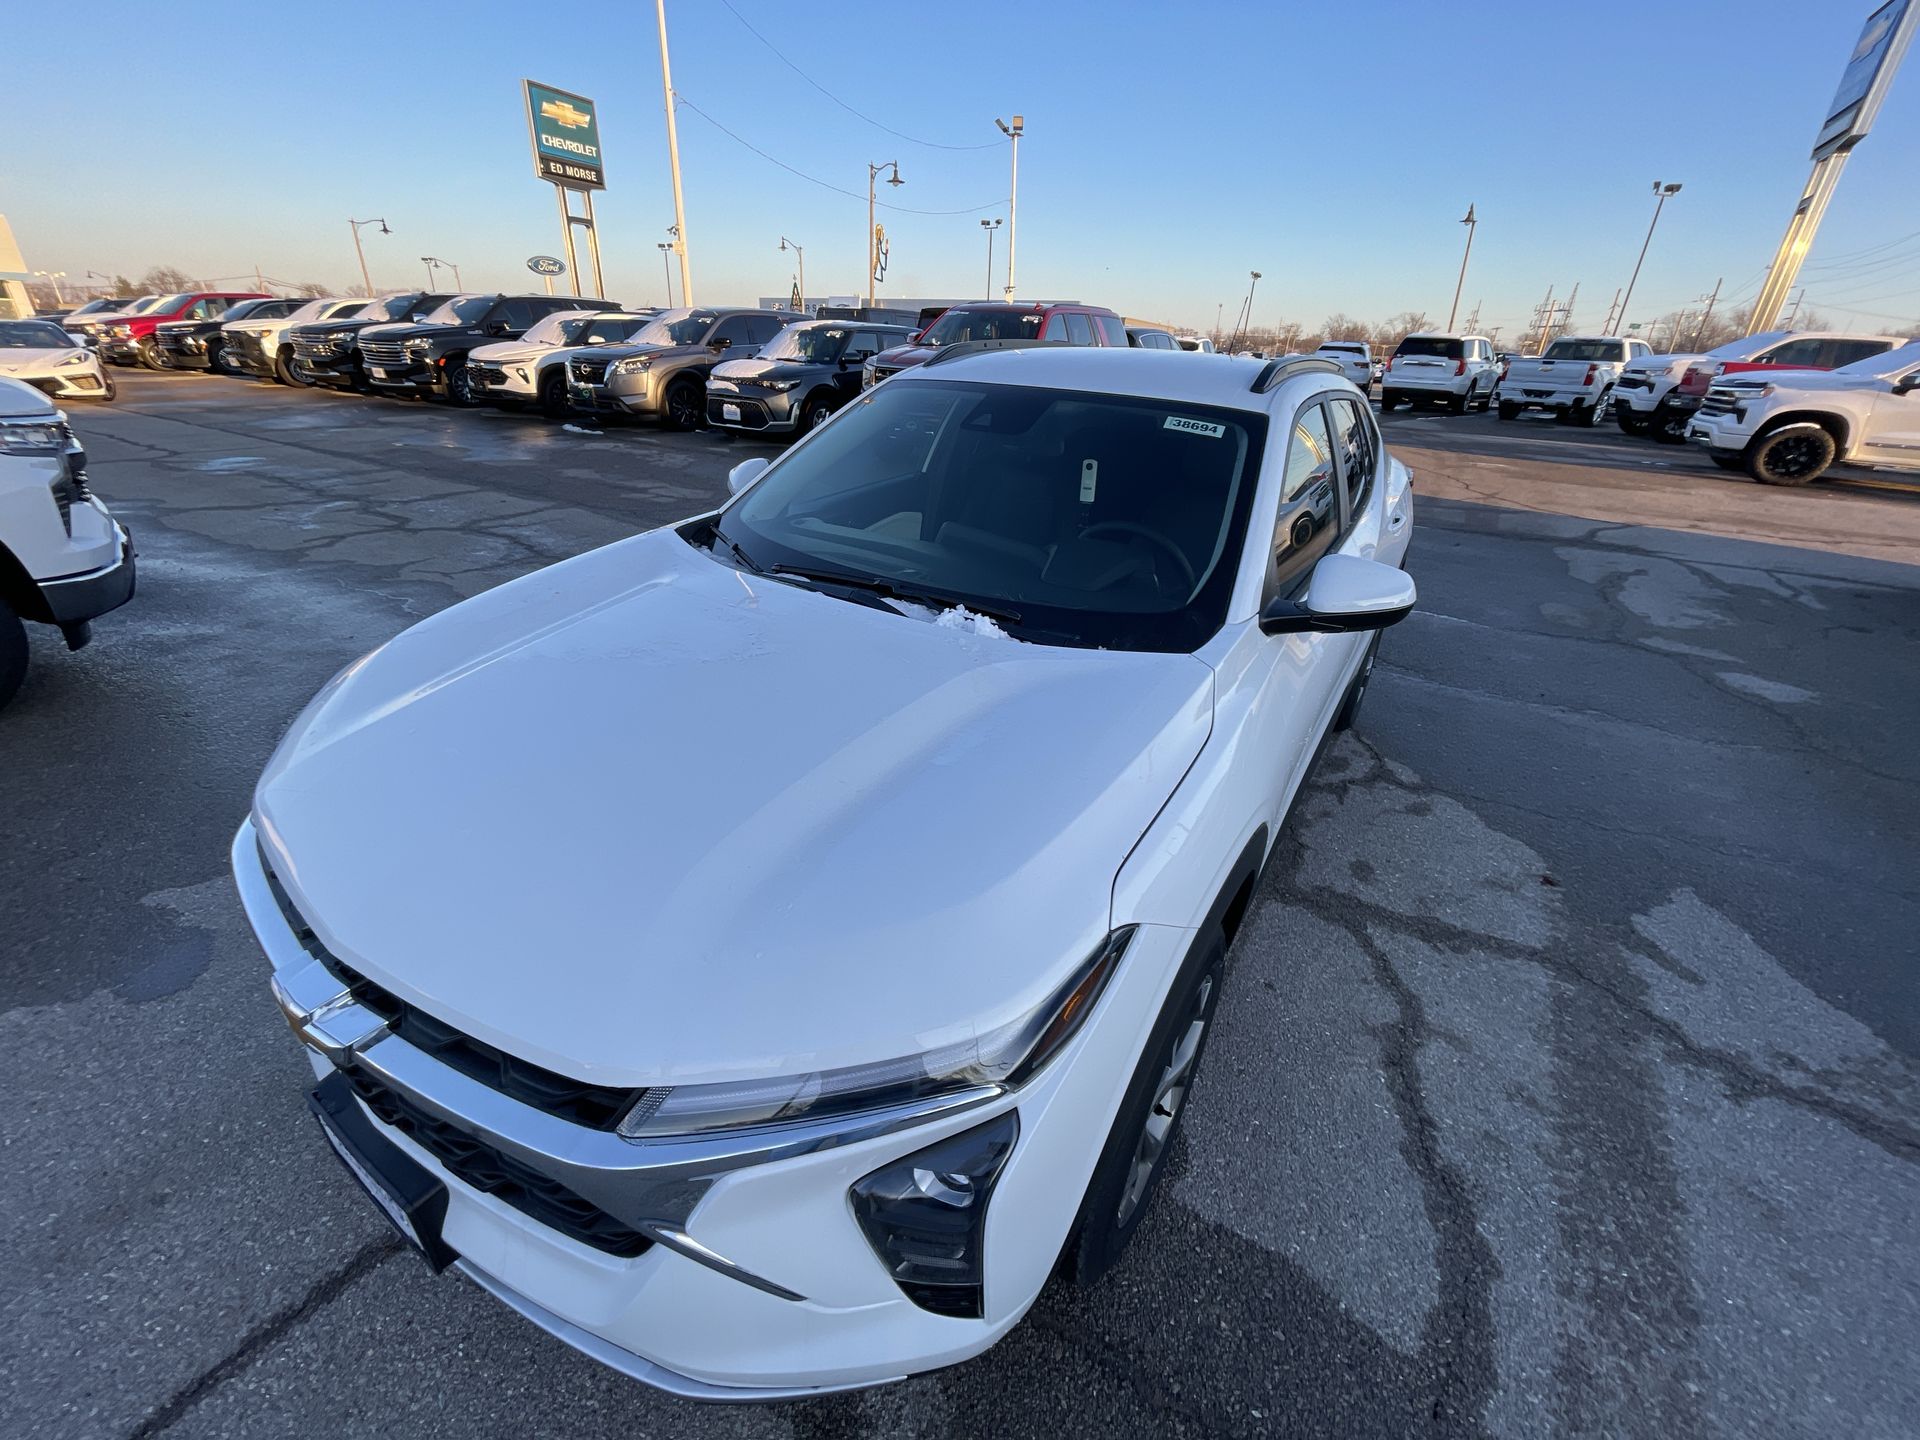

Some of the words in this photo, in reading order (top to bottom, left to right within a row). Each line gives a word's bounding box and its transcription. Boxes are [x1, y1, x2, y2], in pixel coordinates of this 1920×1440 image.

[541, 134, 597, 157] CHEVROLET
[550, 162, 563, 174] ED
[566, 165, 598, 181] MORSE
[538, 259, 560, 272] Ford
[1172, 419, 1218, 433] 38694
